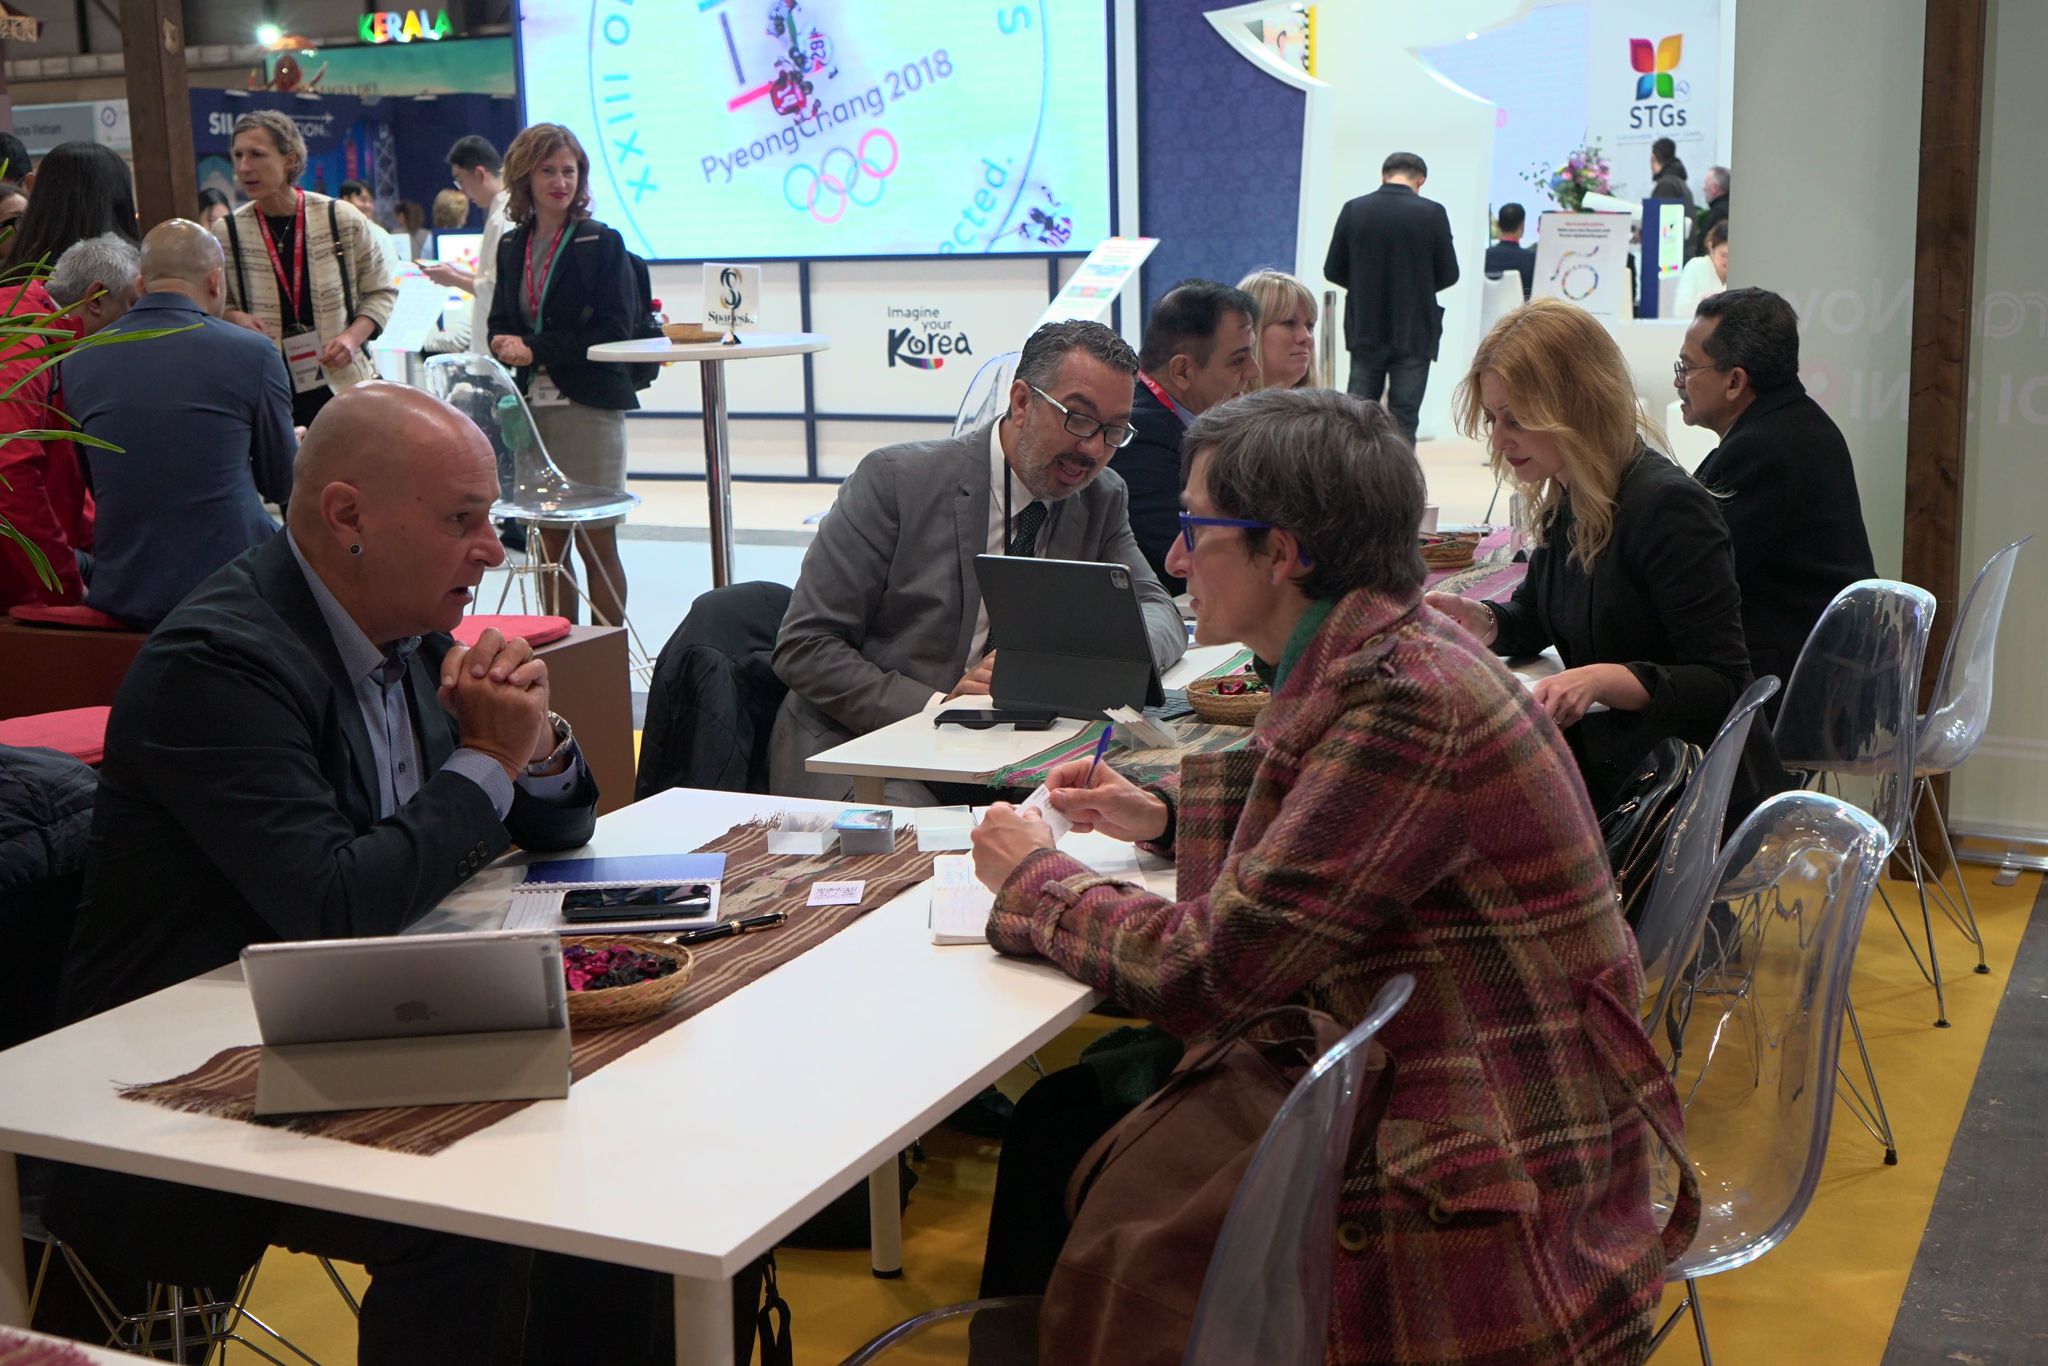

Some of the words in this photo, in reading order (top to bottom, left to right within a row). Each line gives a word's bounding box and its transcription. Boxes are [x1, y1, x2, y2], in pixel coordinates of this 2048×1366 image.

[358, 8, 453, 43] KERALA
[884, 48, 953, 101] 2018
[1630, 104, 1687, 129] STGs
[887, 305, 940, 321] Imagine
[921, 320, 952, 333] your
[887, 327, 973, 370] Korea
